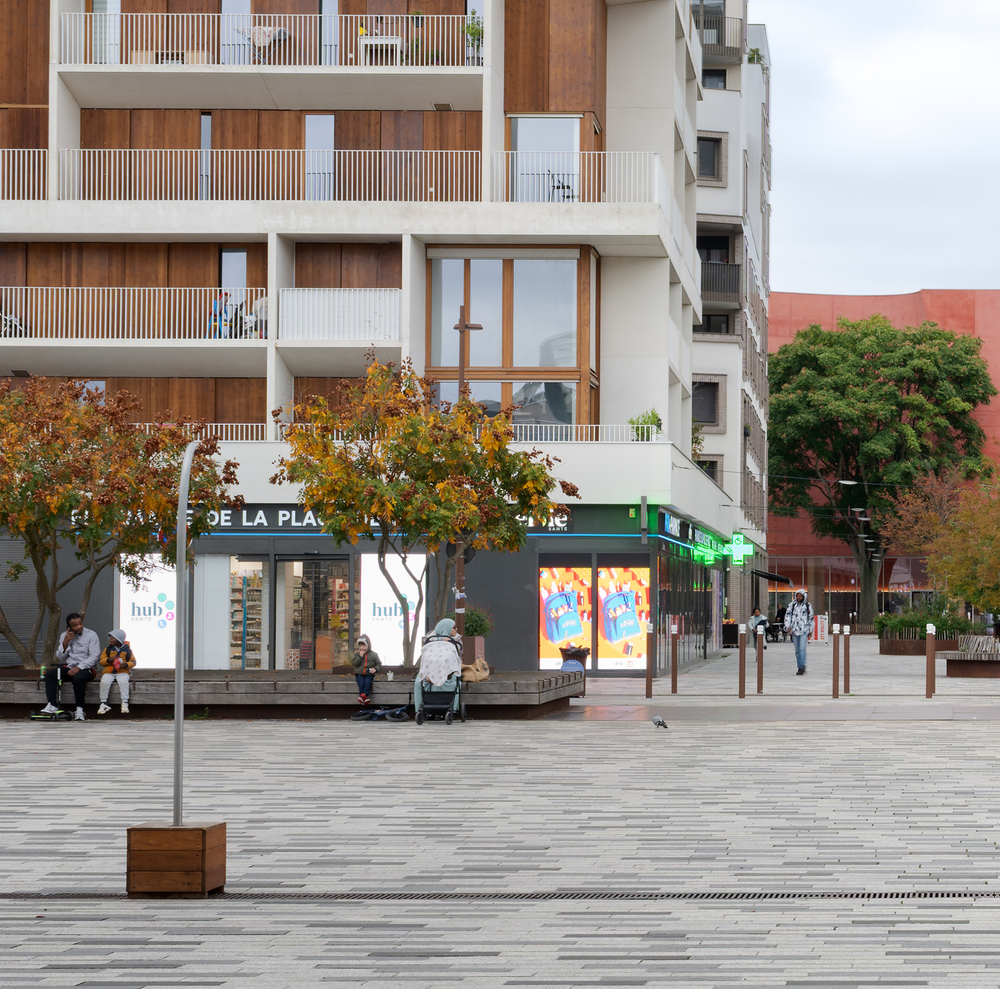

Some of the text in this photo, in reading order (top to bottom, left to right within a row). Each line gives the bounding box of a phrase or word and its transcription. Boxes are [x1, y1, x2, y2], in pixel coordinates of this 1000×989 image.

[207, 510, 232, 526] DE
[242, 510, 268, 526] LA
[131, 602, 163, 617] hub
[372, 602, 404, 617] hub
